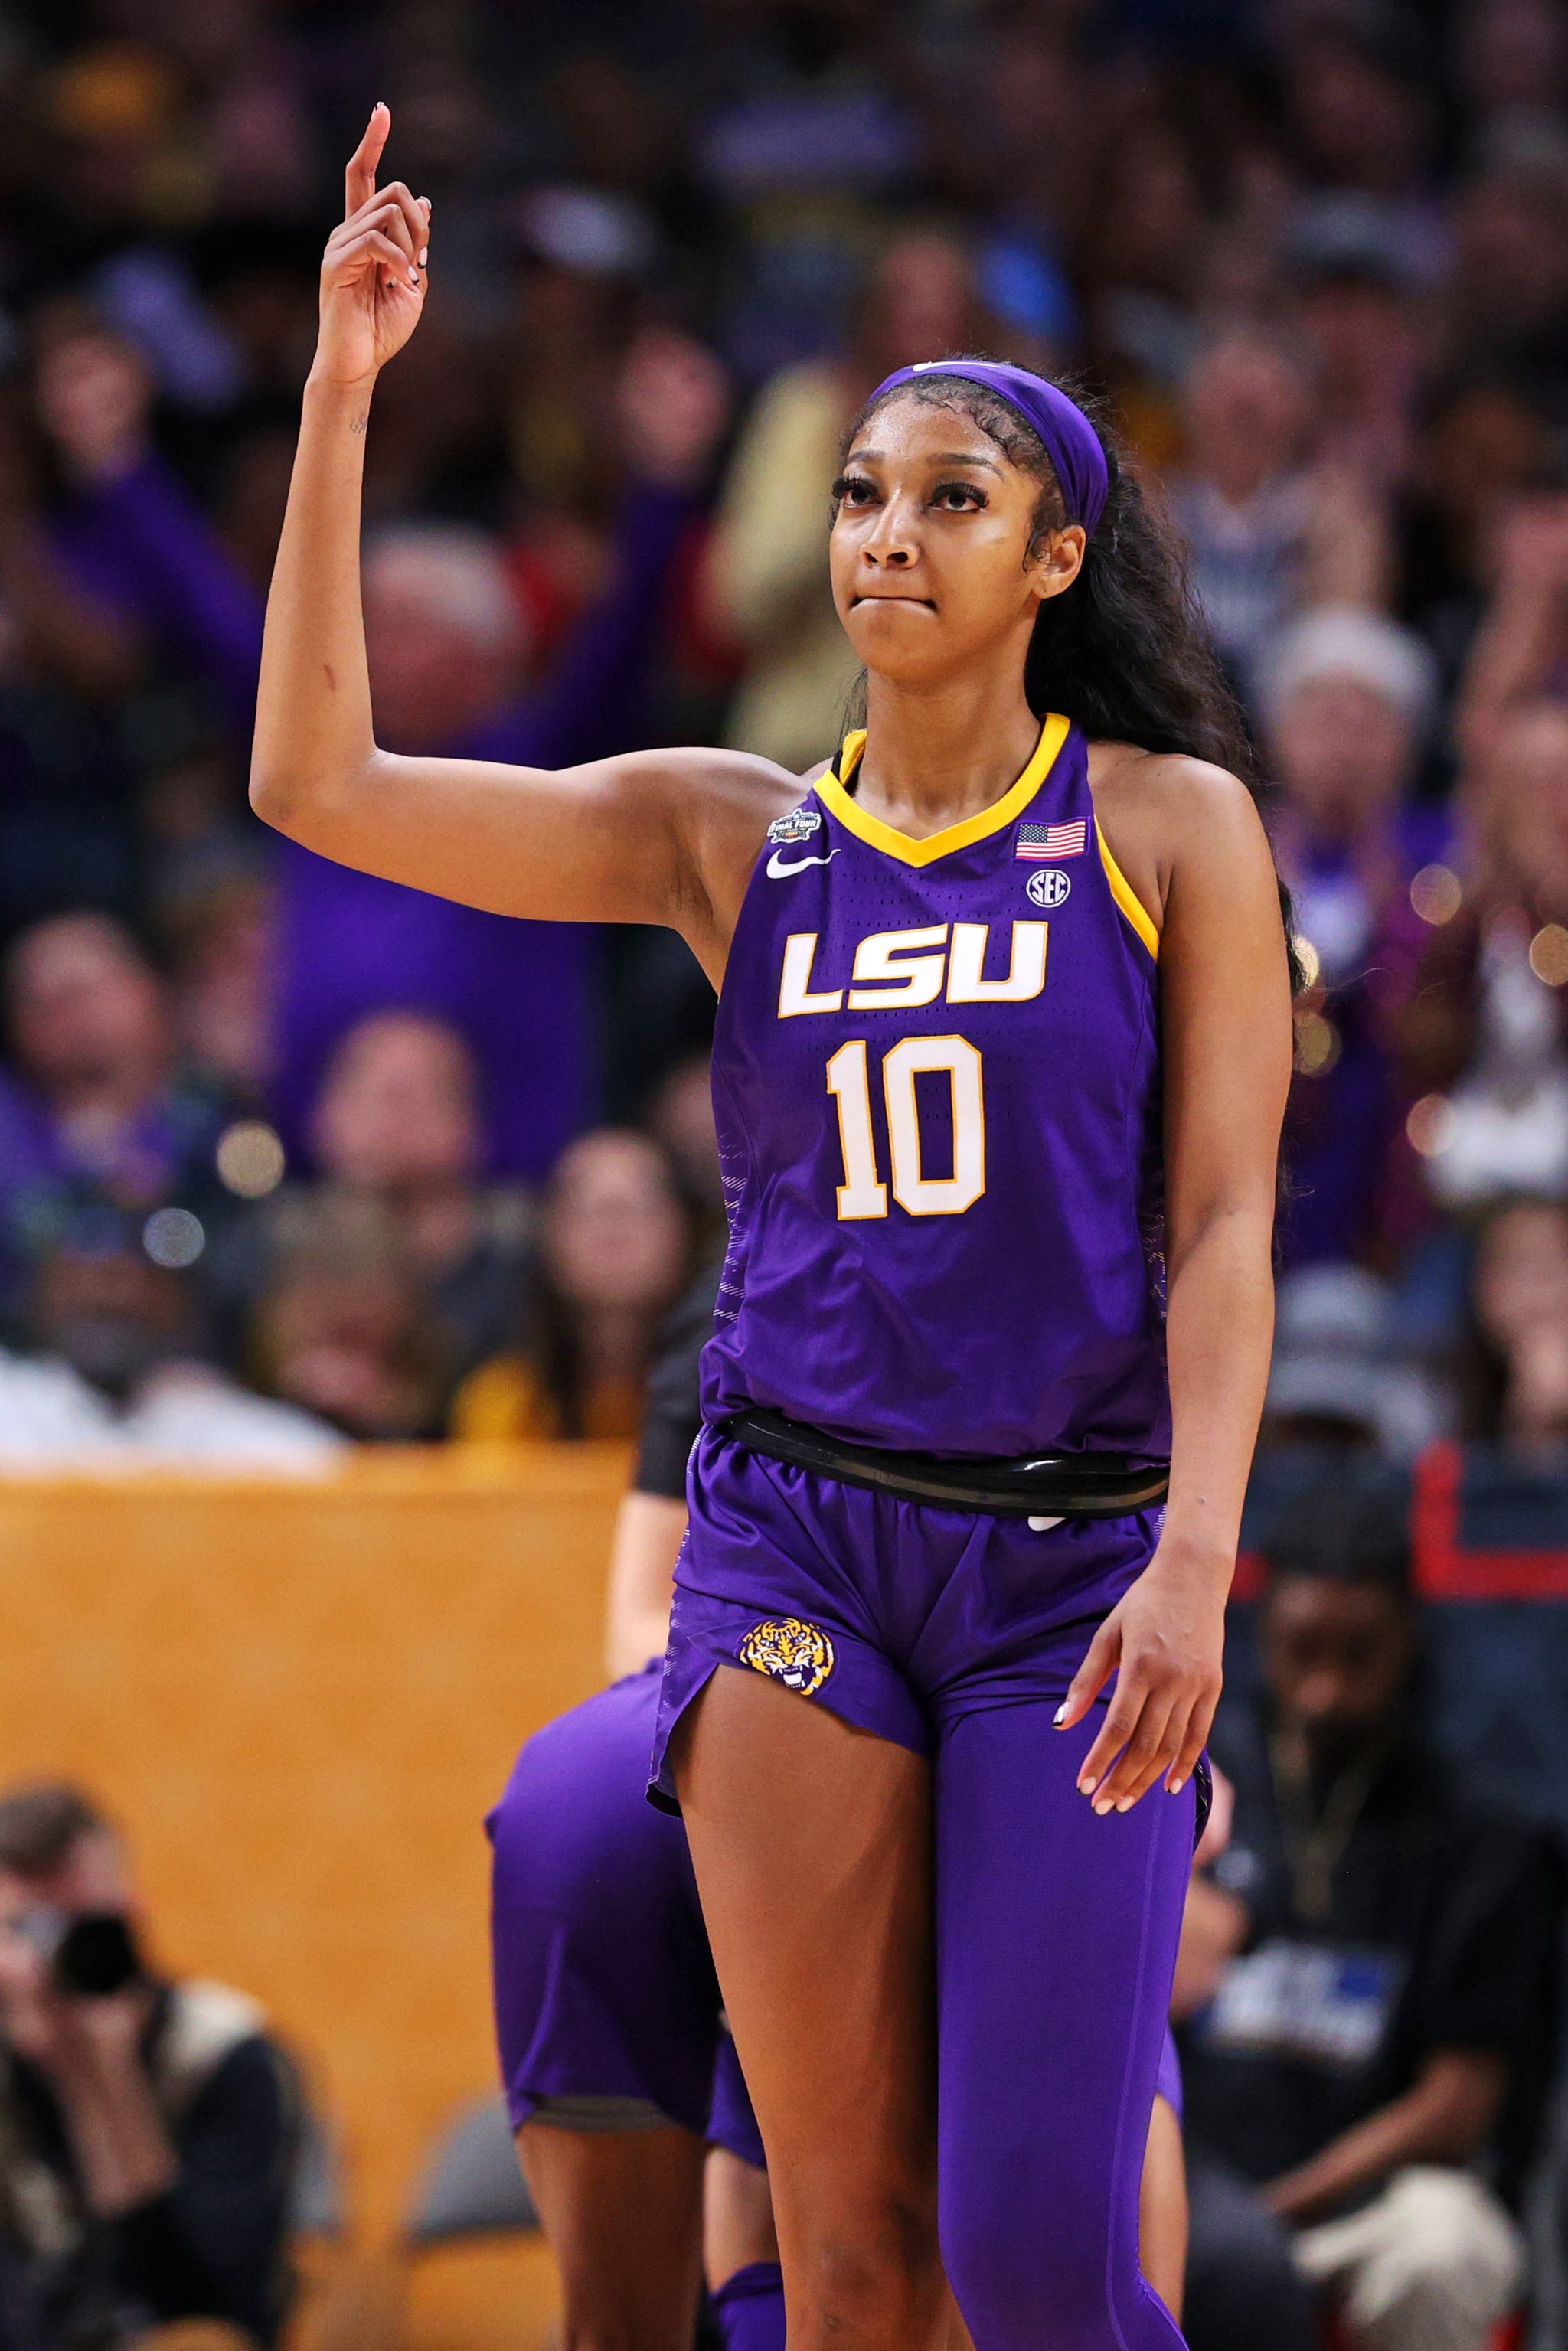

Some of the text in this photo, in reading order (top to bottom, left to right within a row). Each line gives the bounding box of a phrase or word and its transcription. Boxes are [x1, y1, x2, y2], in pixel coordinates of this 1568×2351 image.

[795, 819, 817, 828] FOUR
[1031, 873, 1067, 904] SEC
[778, 920, 1049, 1019] LSU
[826, 1034, 985, 1221] 10
